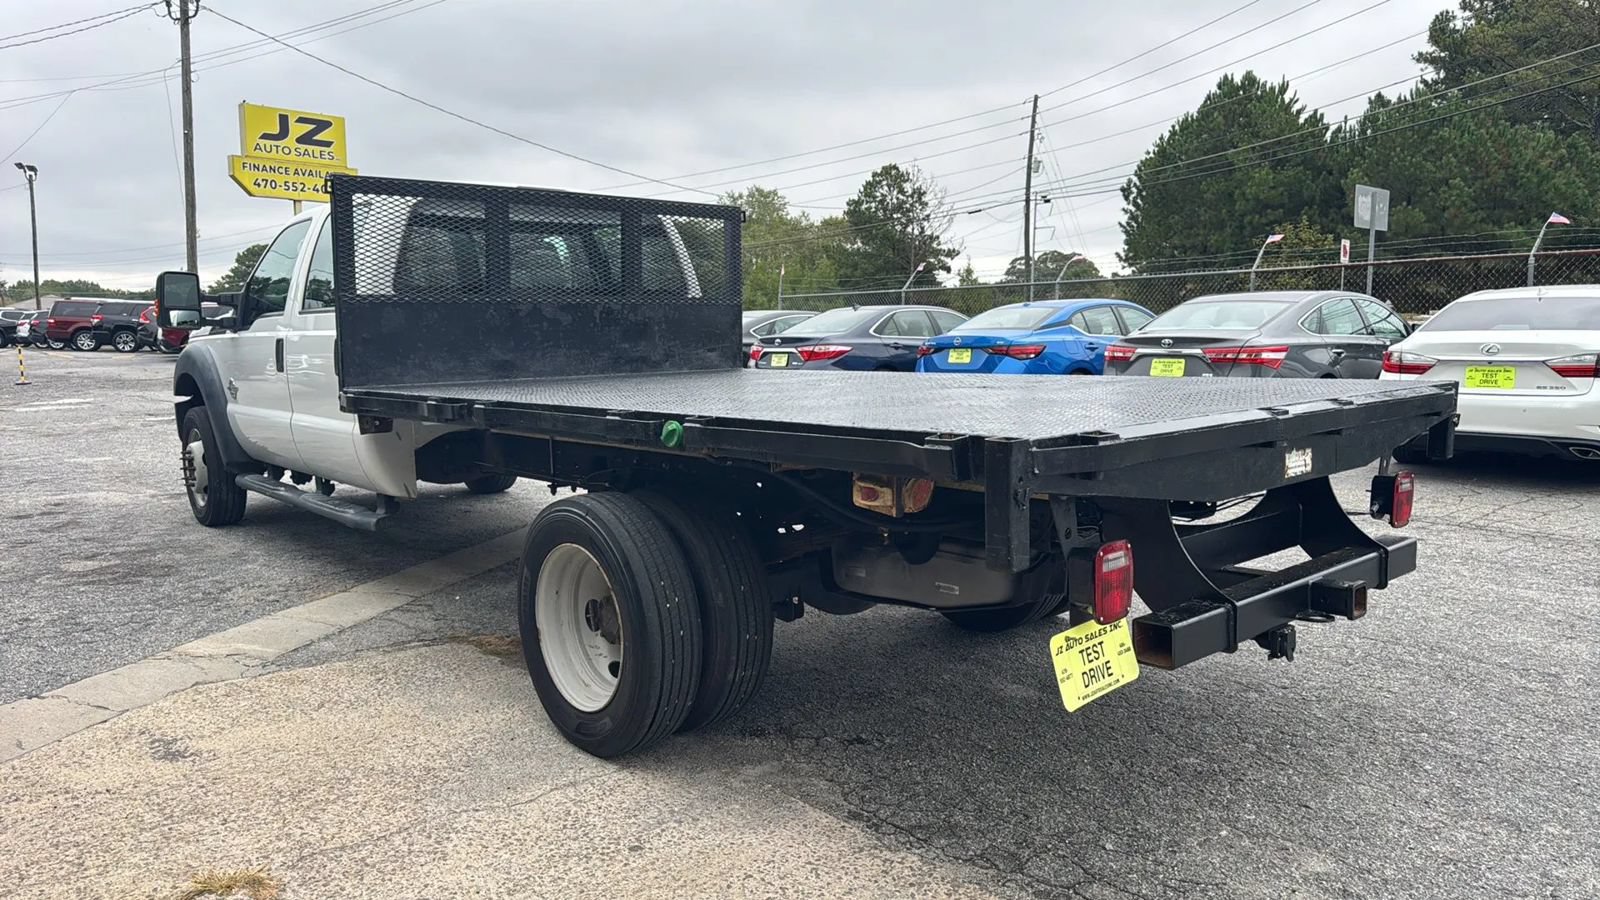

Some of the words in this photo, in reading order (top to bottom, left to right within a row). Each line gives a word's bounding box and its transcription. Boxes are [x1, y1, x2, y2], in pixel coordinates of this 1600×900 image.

[258, 113, 335, 148] JZ
[253, 142, 292, 156] AUTO
[294, 147, 335, 161] SALES
[242, 162, 290, 176] FINANCE
[293, 168, 332, 179] AVAILA
[1055, 645, 1064, 656] JZ
[1065, 637, 1084, 652] AUTO
[1084, 626, 1108, 643] SALES
[1109, 620, 1123, 633] INC
[1078, 641, 1105, 666] TEST
[1081, 660, 1114, 689] DRIVE
